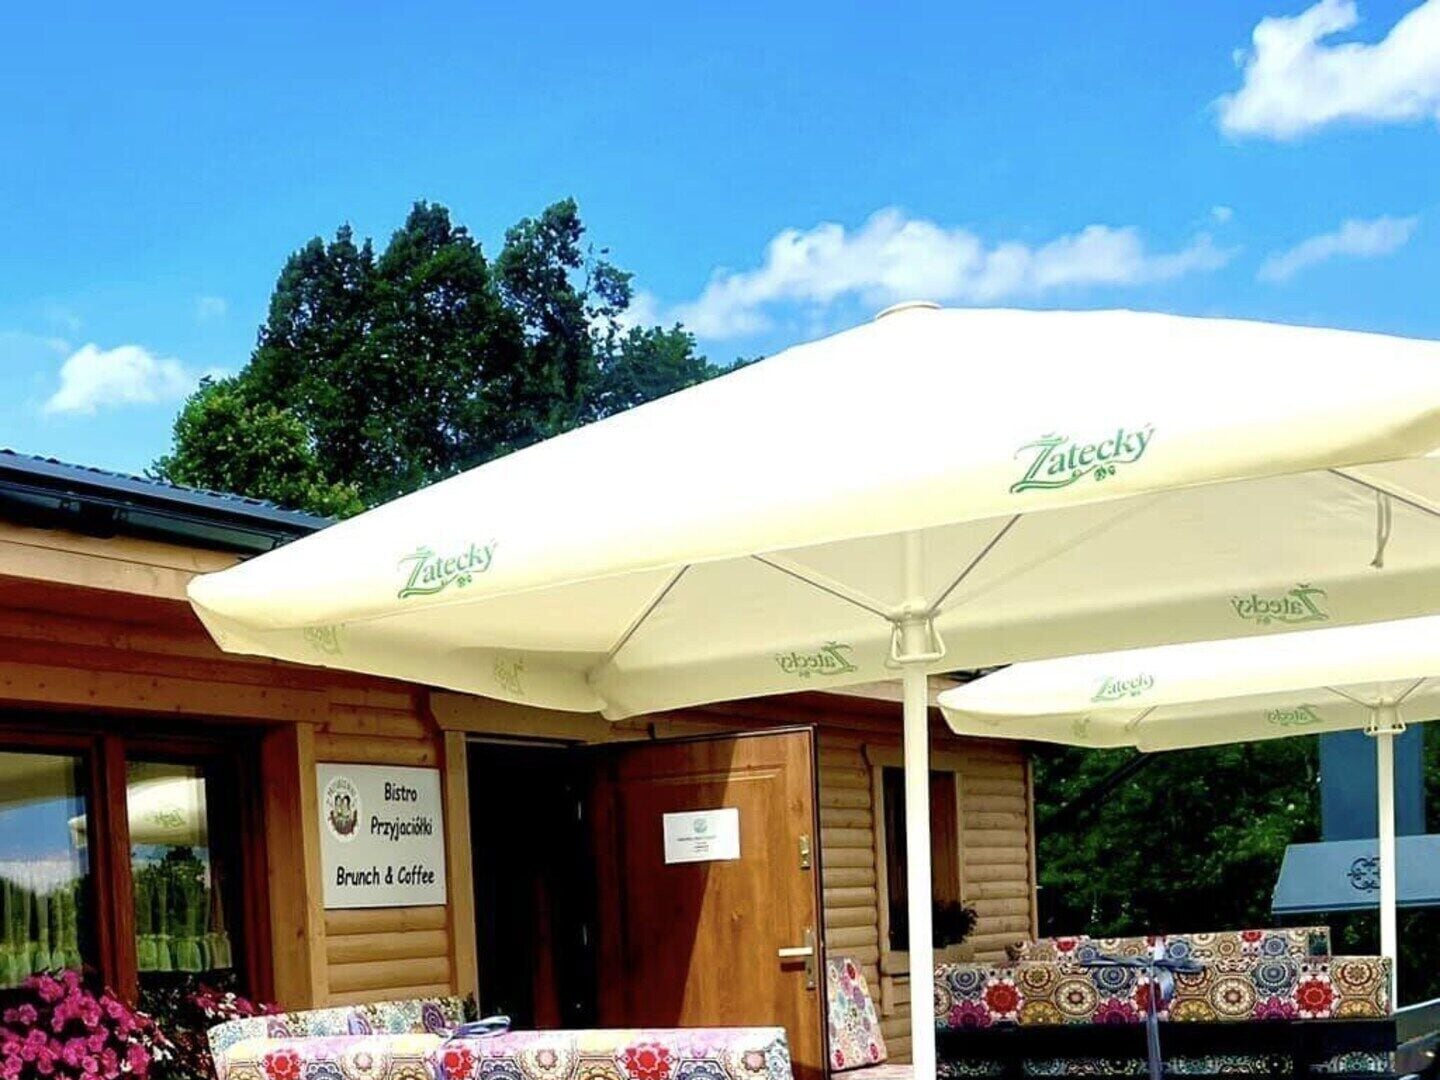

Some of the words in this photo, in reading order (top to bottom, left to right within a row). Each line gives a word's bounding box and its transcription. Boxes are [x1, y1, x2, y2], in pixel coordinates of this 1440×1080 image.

[384, 781, 419, 802] Bistro
[370, 815, 433, 842] Przyjaciółki
[336, 866, 380, 886] Brunch
[384, 866, 393, 885] &
[397, 864, 435, 885] Coffee
